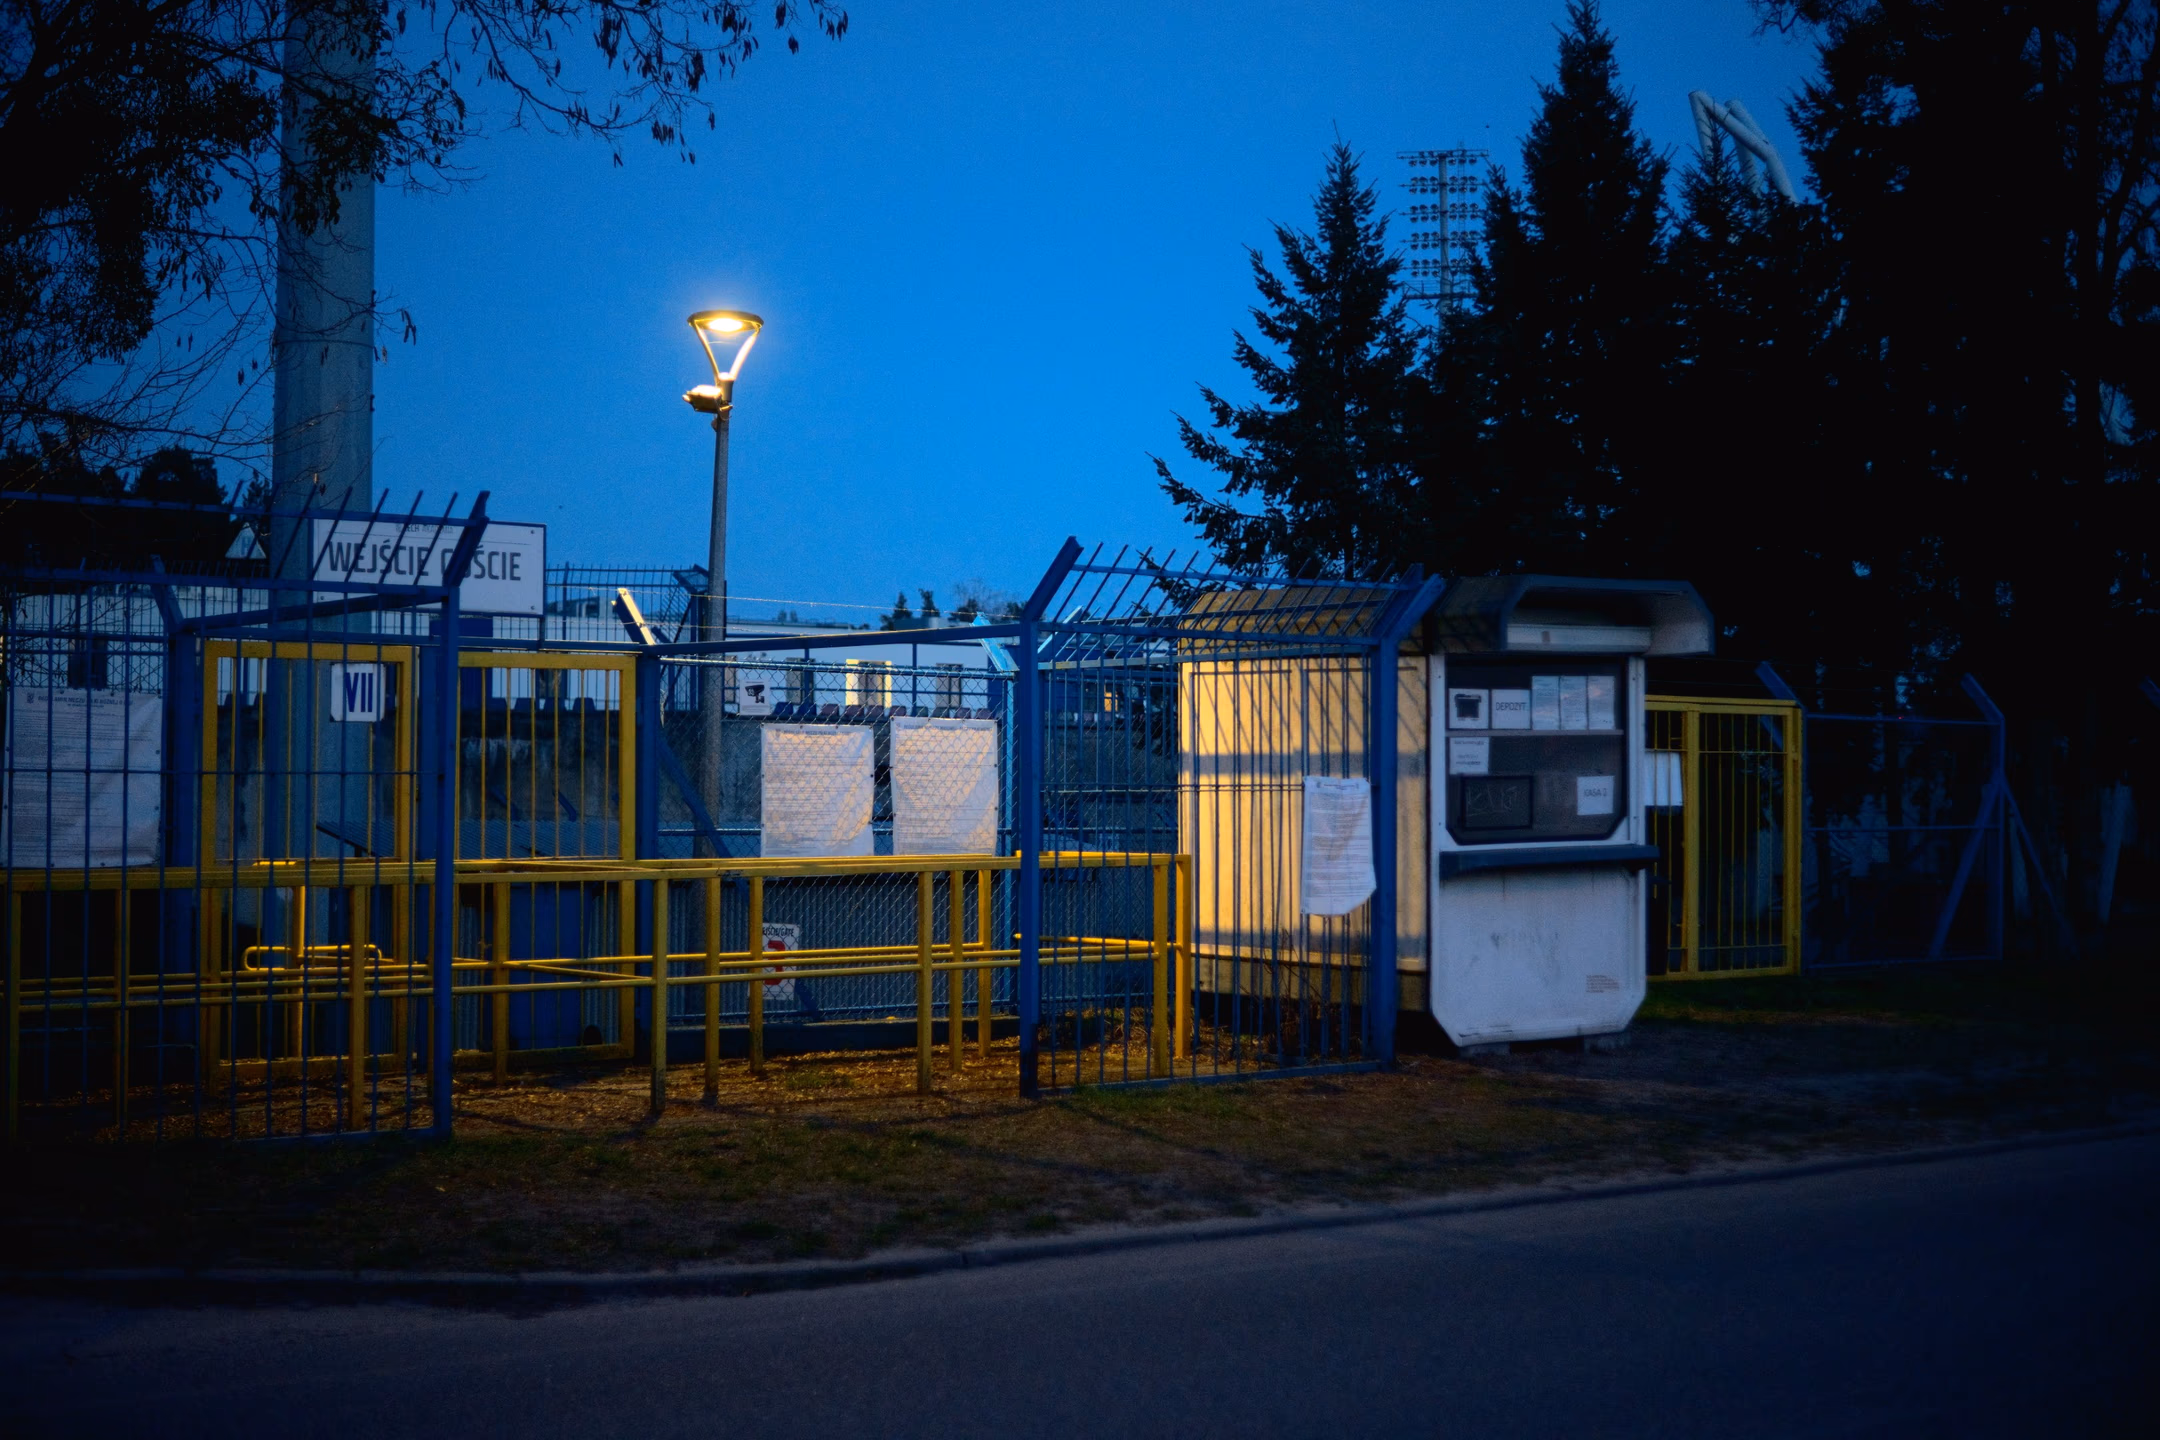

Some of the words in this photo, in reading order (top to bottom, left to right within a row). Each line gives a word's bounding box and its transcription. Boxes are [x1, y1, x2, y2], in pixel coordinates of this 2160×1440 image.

[328, 539, 430, 577] WEJŚCIE
[440, 544, 522, 582] GŚCIE
[345, 671, 374, 713] VII
[1495, 702, 1527, 711] DEPOZYT
